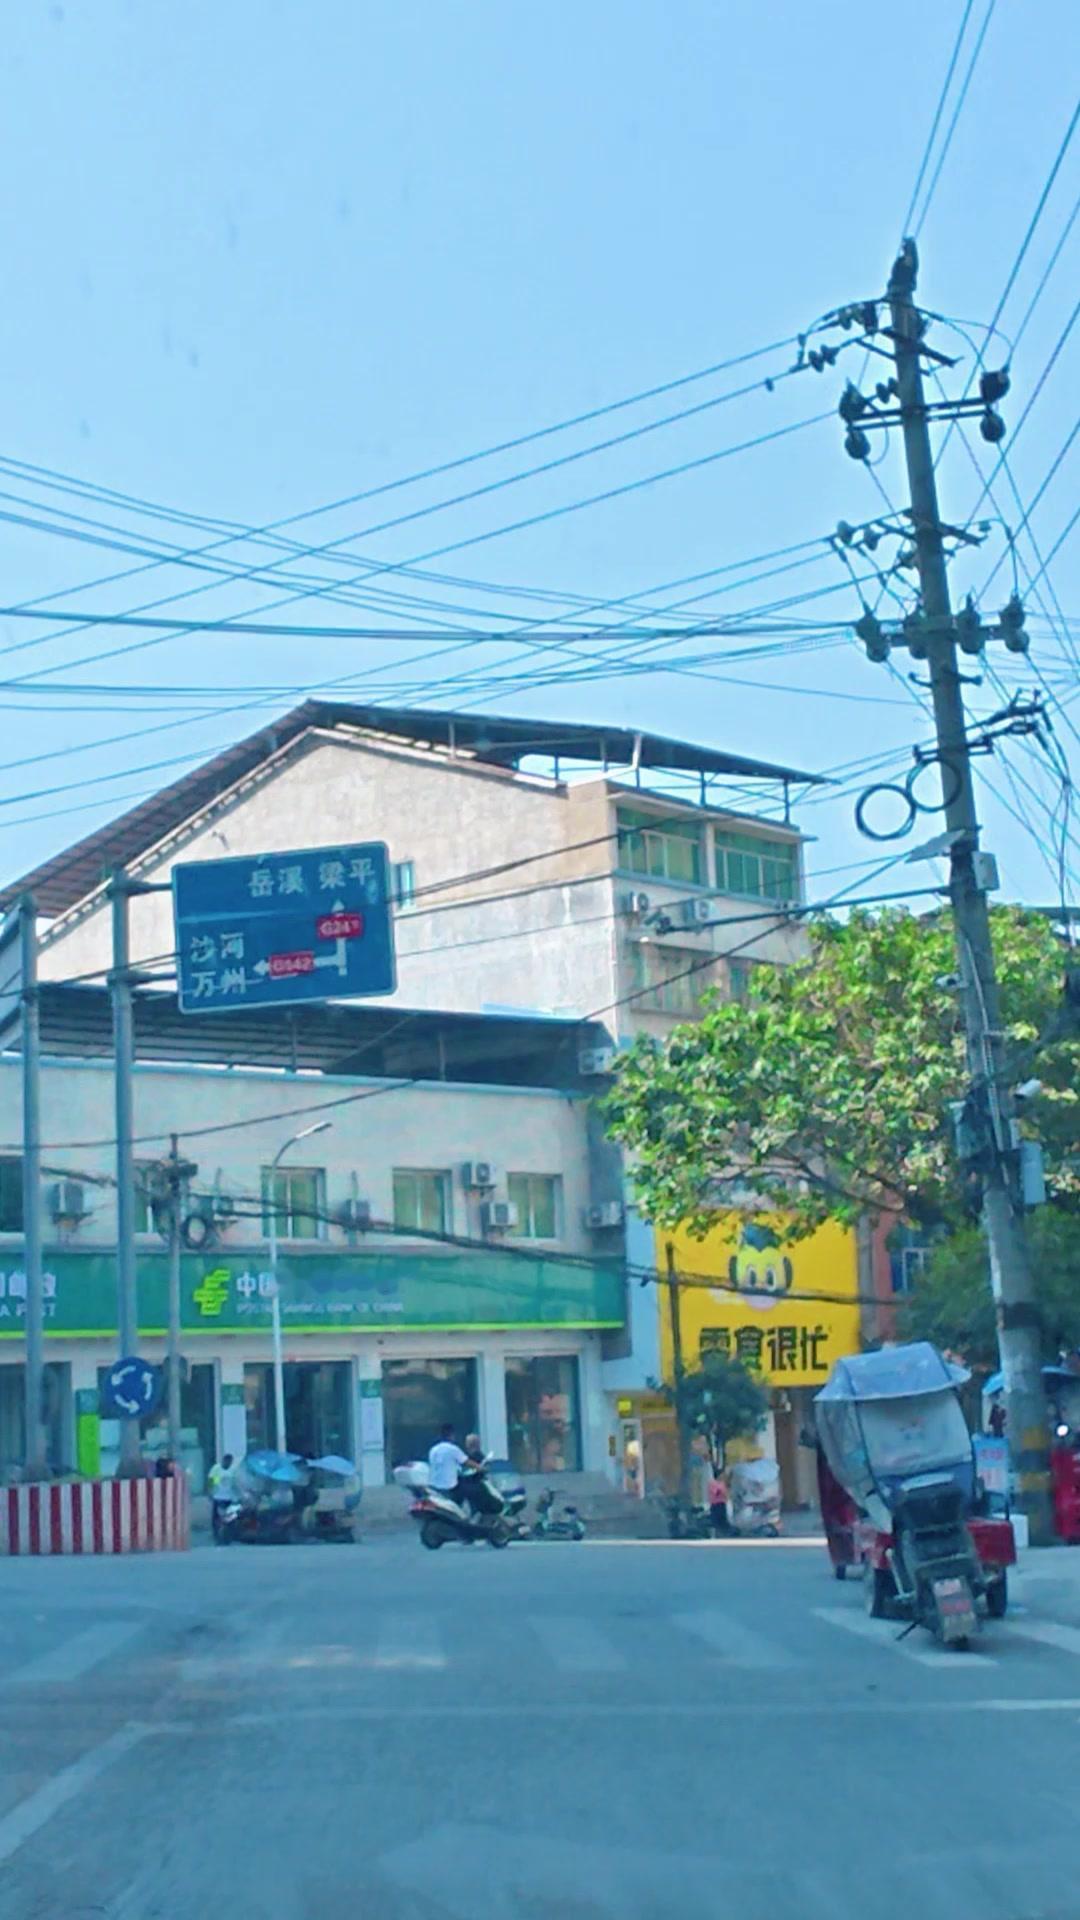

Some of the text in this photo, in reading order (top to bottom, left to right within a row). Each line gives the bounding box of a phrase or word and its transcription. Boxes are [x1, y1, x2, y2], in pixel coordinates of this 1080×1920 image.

[248, 865, 304, 897] 岳溪
[190, 932, 244, 963] 沙河
[191, 966, 247, 997] 万州
